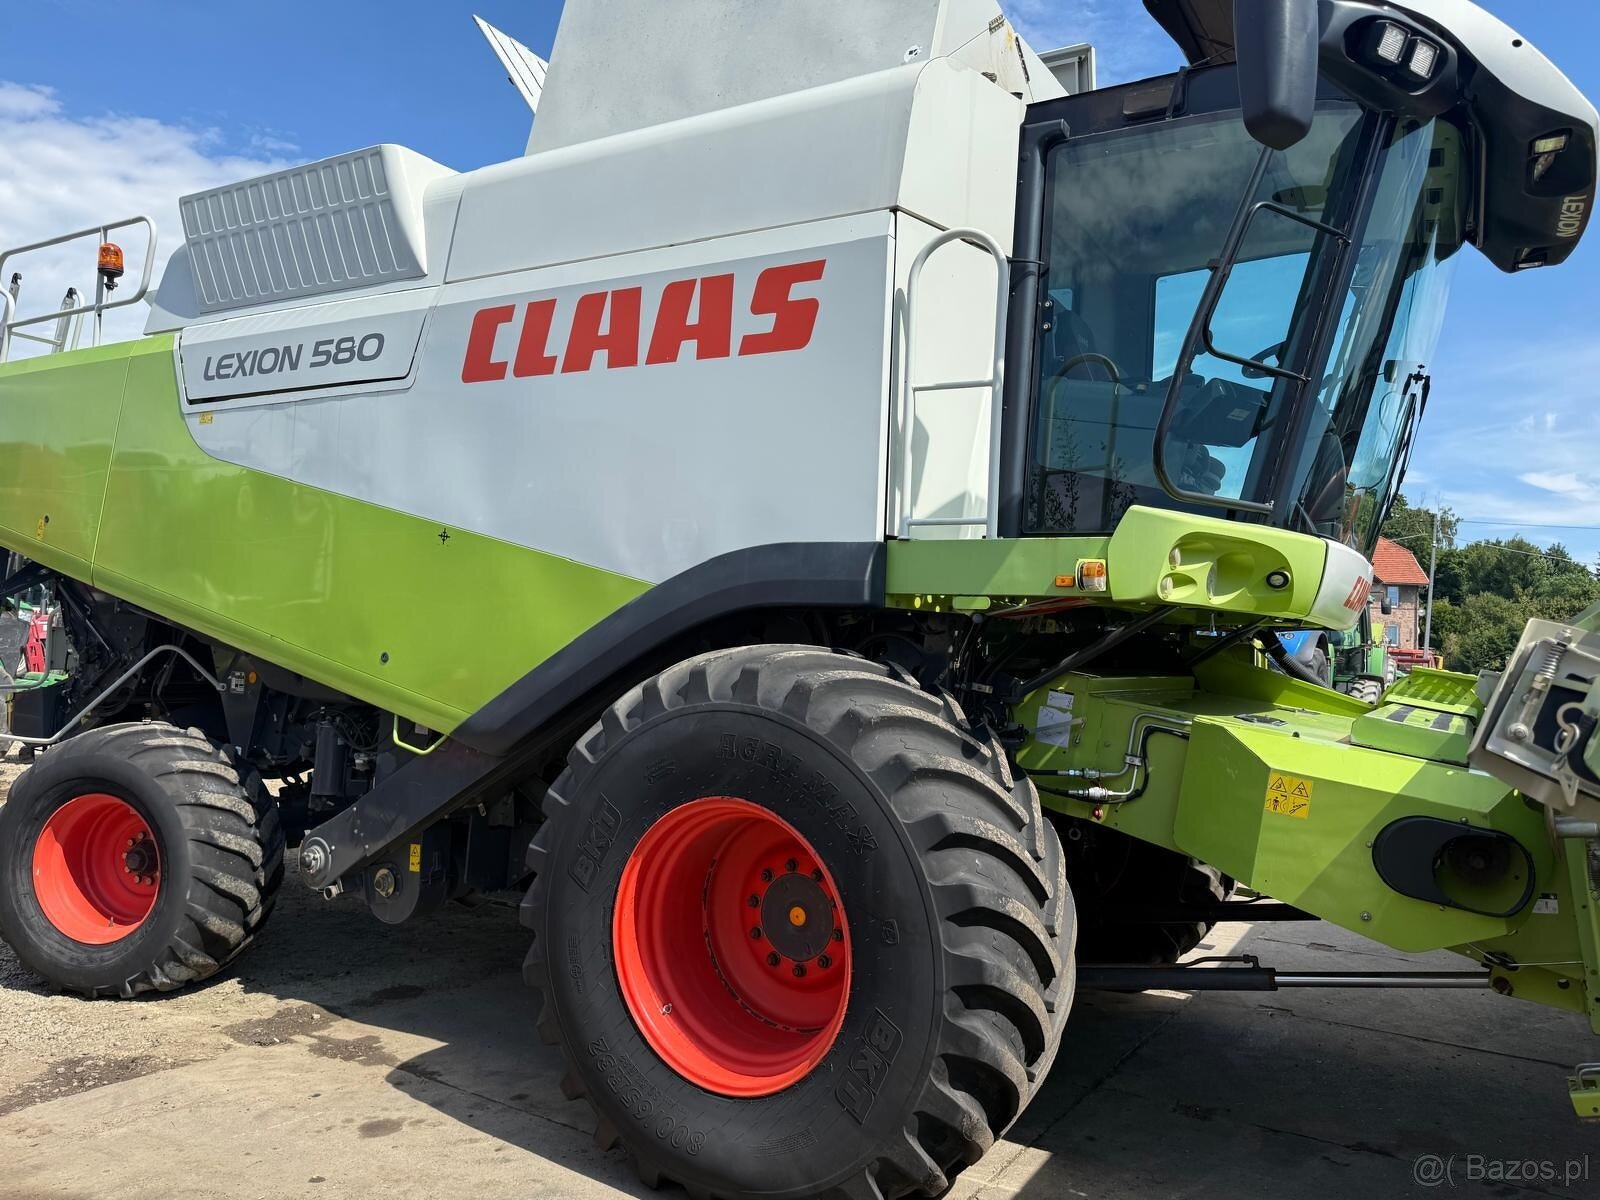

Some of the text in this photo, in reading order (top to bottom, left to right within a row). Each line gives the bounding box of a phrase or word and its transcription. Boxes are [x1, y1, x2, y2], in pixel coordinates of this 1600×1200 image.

[1556, 194, 1587, 237] LEXION
[203, 333, 385, 381] LEXION 580
[461, 259, 827, 383] CLAAS
[567, 792, 622, 895] BKT
[835, 1007, 904, 1126] BKT
